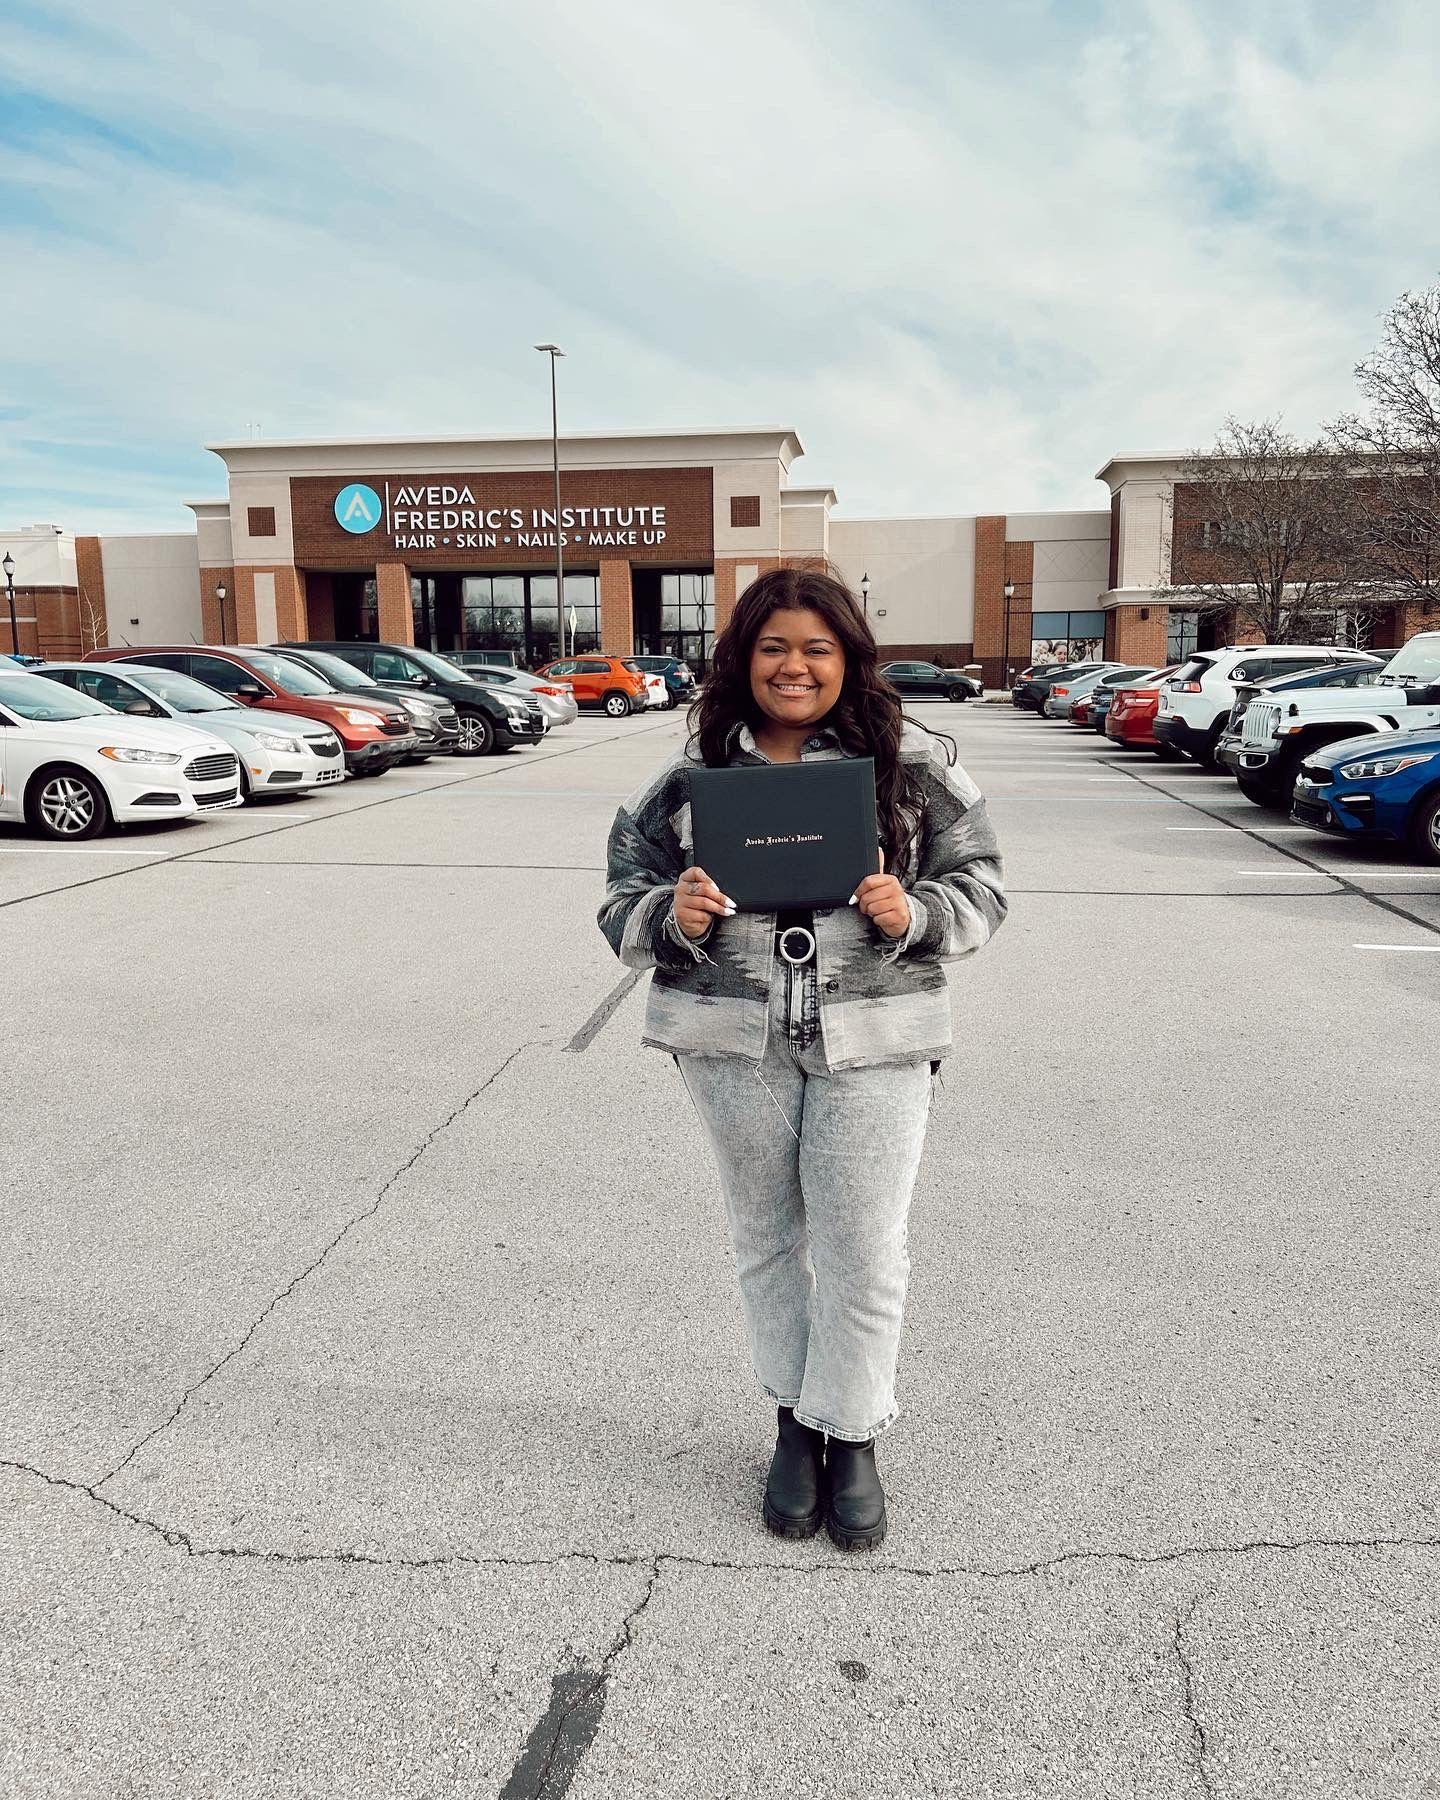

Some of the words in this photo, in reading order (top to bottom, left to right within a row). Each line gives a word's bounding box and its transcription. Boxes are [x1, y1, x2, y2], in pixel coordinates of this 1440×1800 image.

[394, 486, 476, 506] AVEDA
[394, 509, 523, 530] FREDRIC'S
[532, 507, 666, 528] INSTITUTE
[395, 535, 436, 548] HAIR
[456, 533, 497, 548] SKIN
[517, 533, 568, 546] NAILS
[588, 532, 637, 545] MAKE
[643, 531, 666, 544] UP
[744, 838, 765, 847] Aveda
[796, 834, 823, 843] Institute
